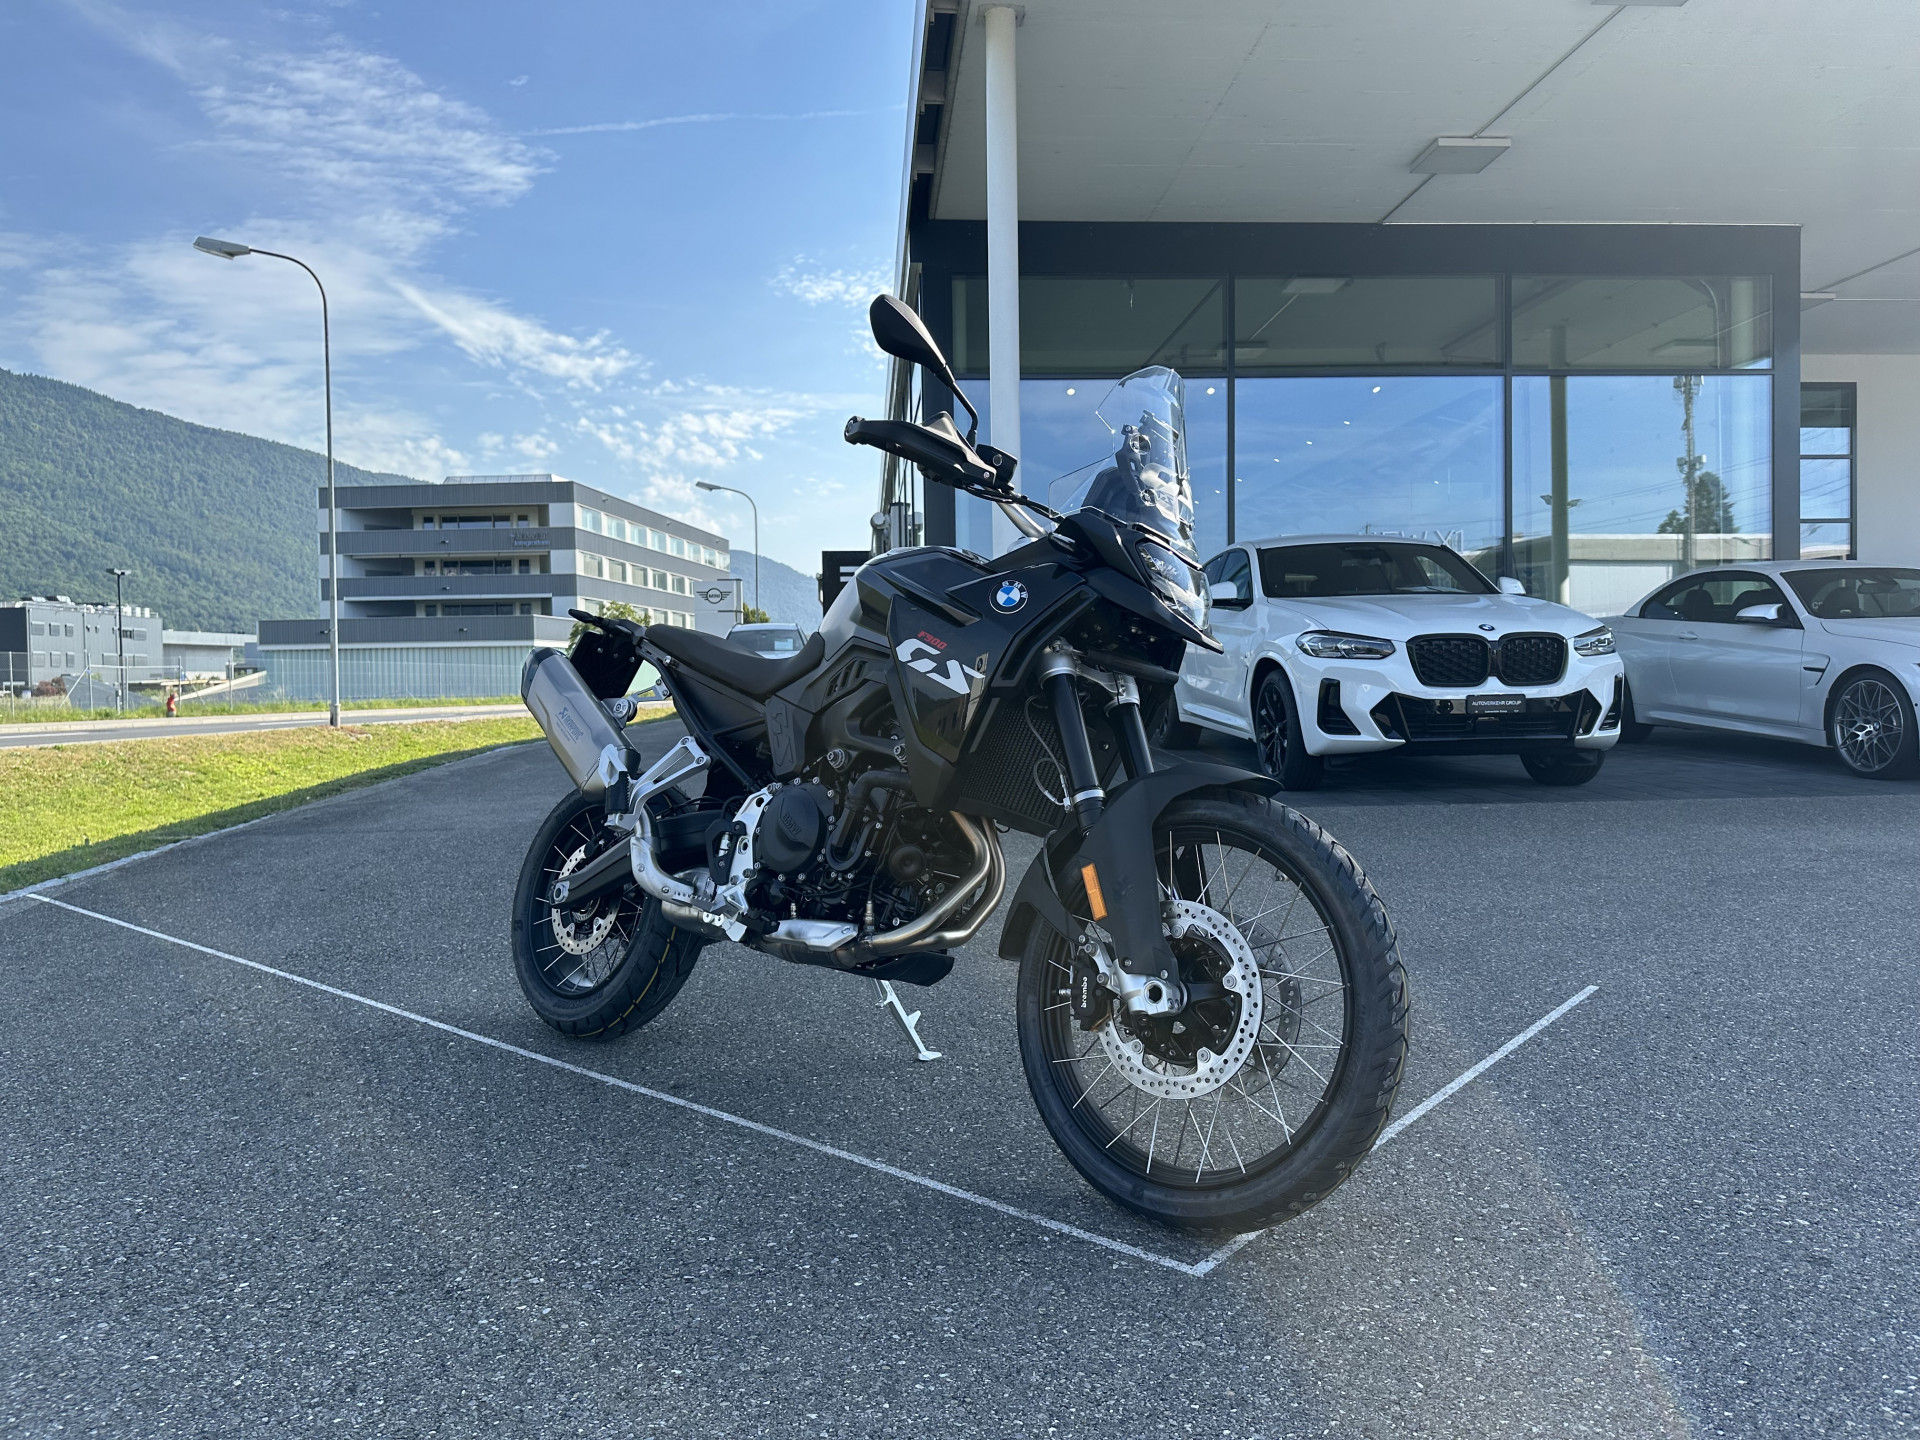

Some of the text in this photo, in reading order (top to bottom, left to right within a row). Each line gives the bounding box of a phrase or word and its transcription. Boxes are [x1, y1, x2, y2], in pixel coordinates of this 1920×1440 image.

[917, 630, 948, 650] F900
[895, 638, 986, 695] GS
[1080, 976, 1088, 1008] brembo
